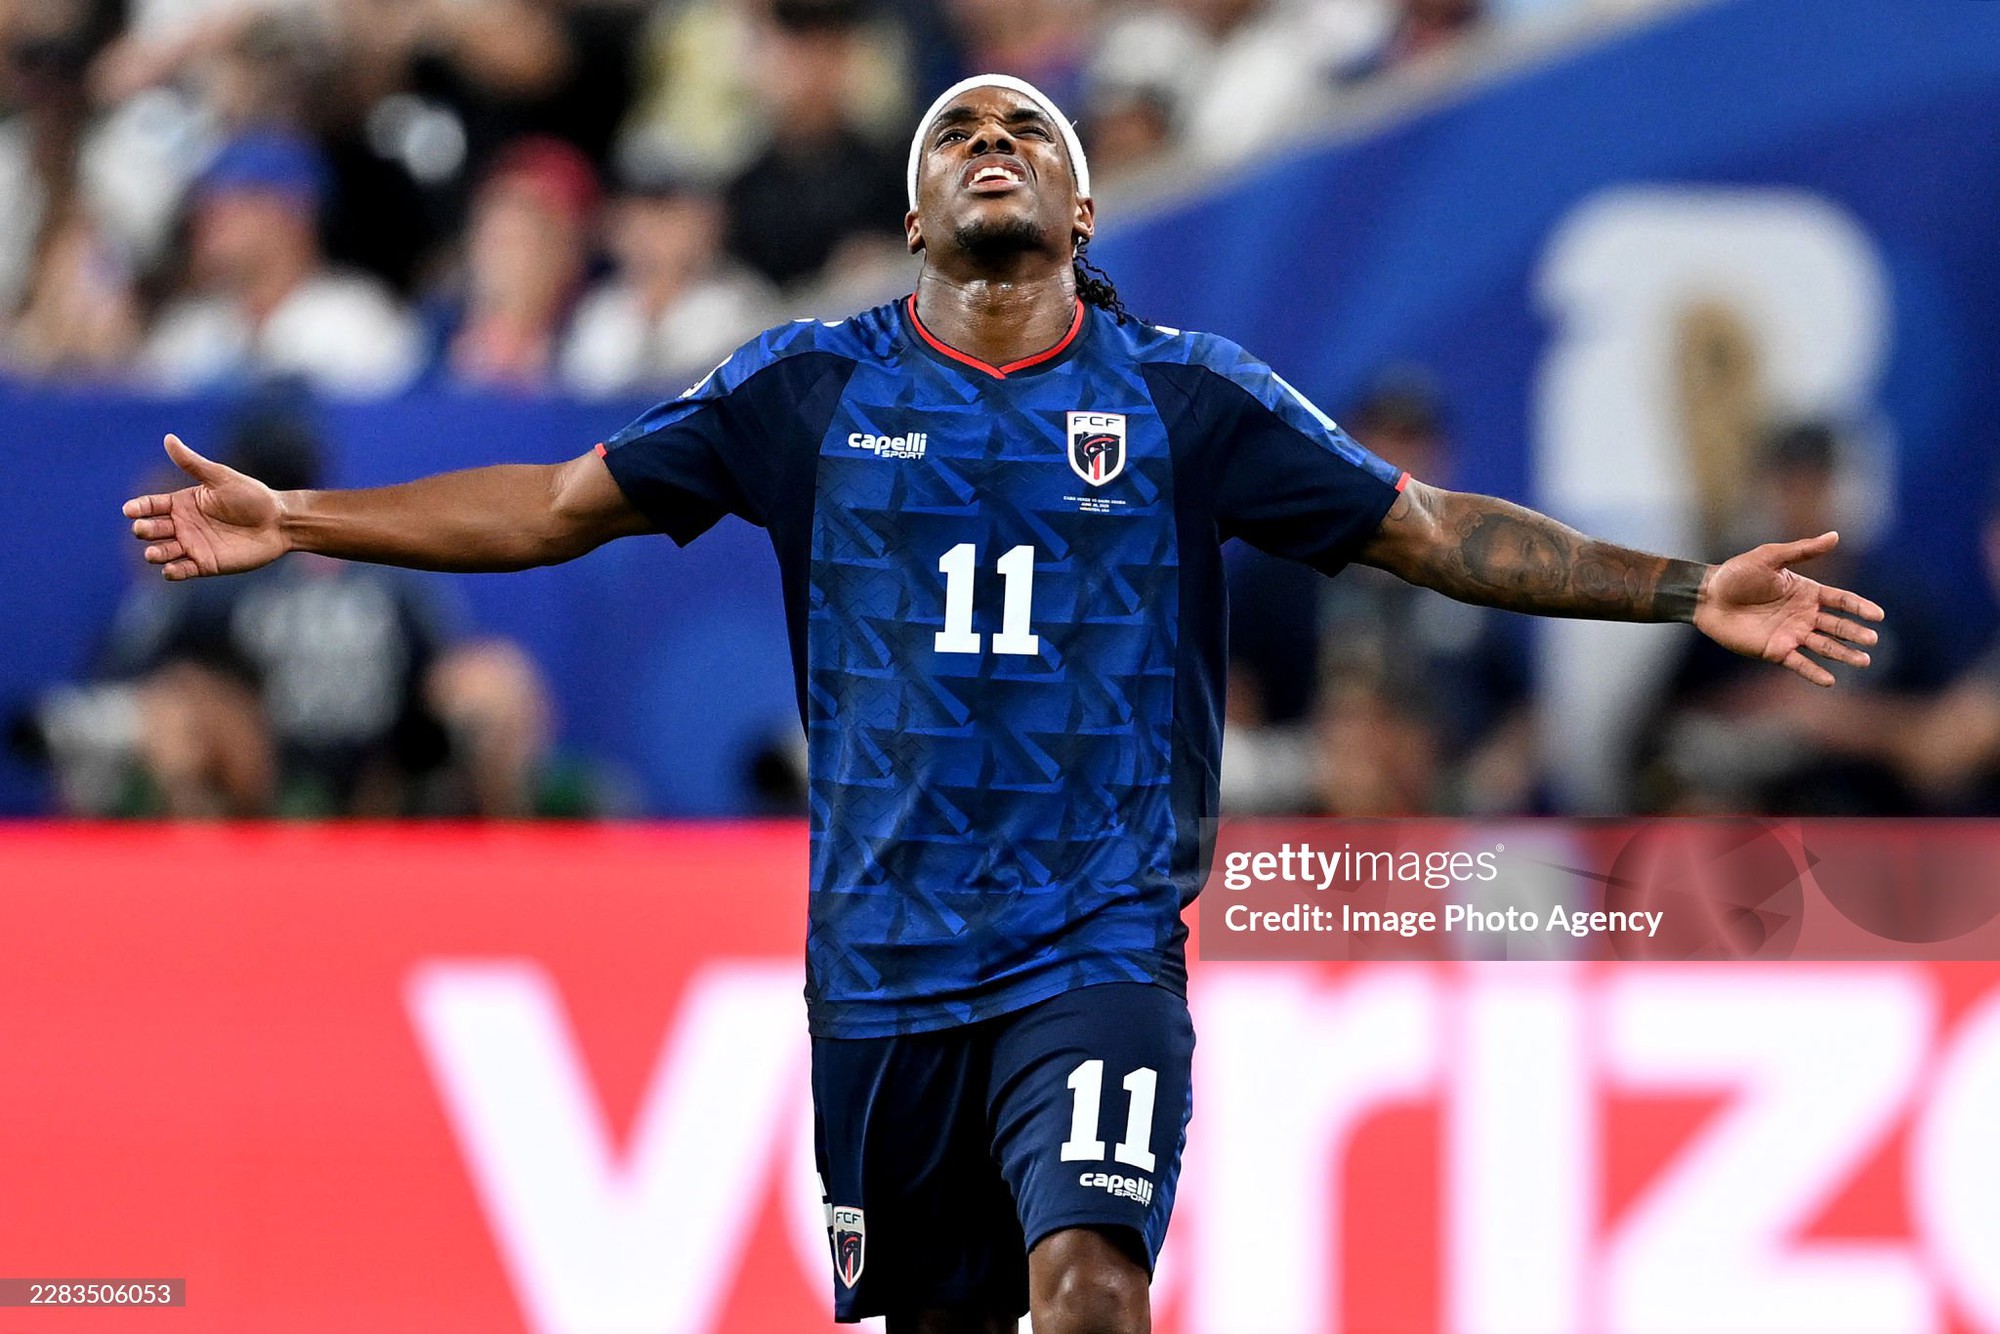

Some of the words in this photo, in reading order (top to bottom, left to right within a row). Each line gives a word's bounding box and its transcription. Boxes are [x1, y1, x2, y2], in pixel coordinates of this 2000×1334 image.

[1073, 416, 1121, 426] FCF
[848, 432, 928, 455] capelli
[881, 450, 926, 460] SPORT
[934, 543, 1039, 655] 11
[402, 828, 2000, 1334] vriz
[1060, 1059, 1157, 1173] 11
[1079, 1172, 1154, 1202] capelli
[1114, 1188, 1150, 1208] SPORT
[835, 1211, 862, 1224] FCF
